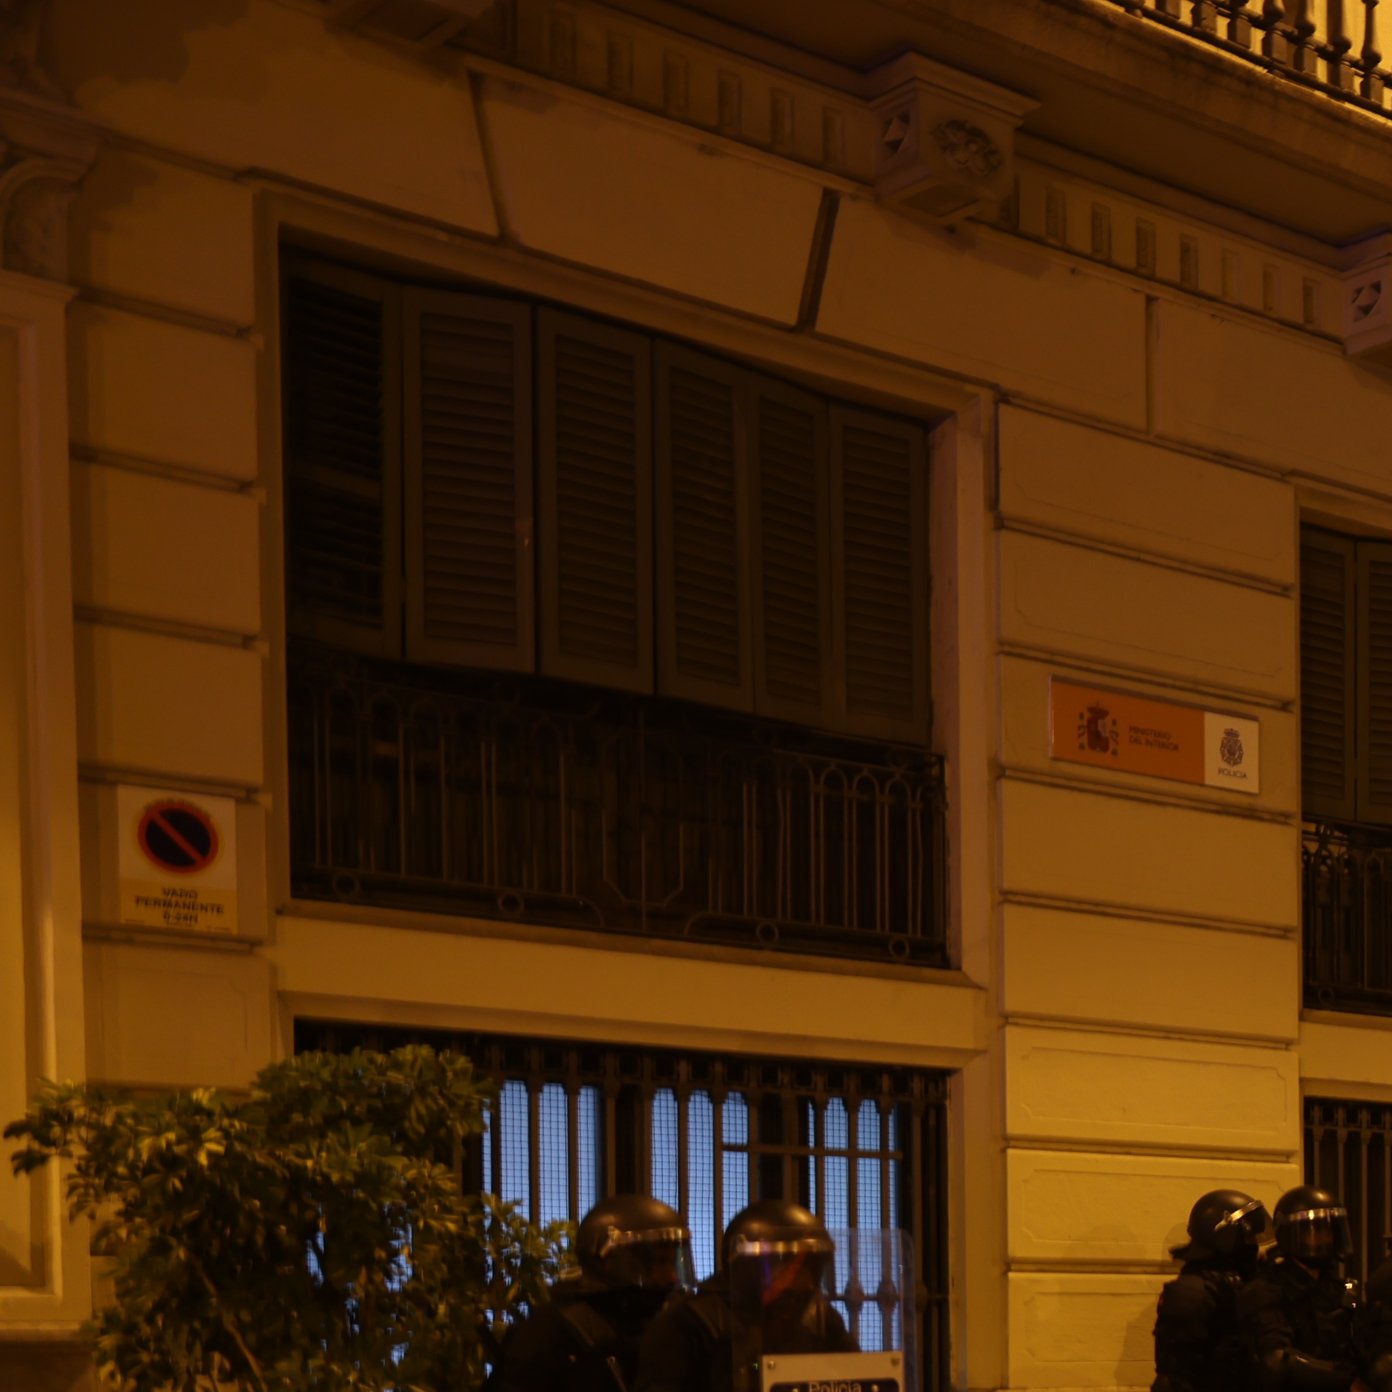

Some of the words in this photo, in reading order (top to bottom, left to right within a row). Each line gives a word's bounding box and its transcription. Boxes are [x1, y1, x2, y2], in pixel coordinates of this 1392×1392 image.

[1128, 725, 1171, 741] MINISTERIO
[1128, 735, 1143, 746] DEL
[1144, 737, 1179, 752] INTERIOR
[134, 896, 225, 914] PERMANENTE
